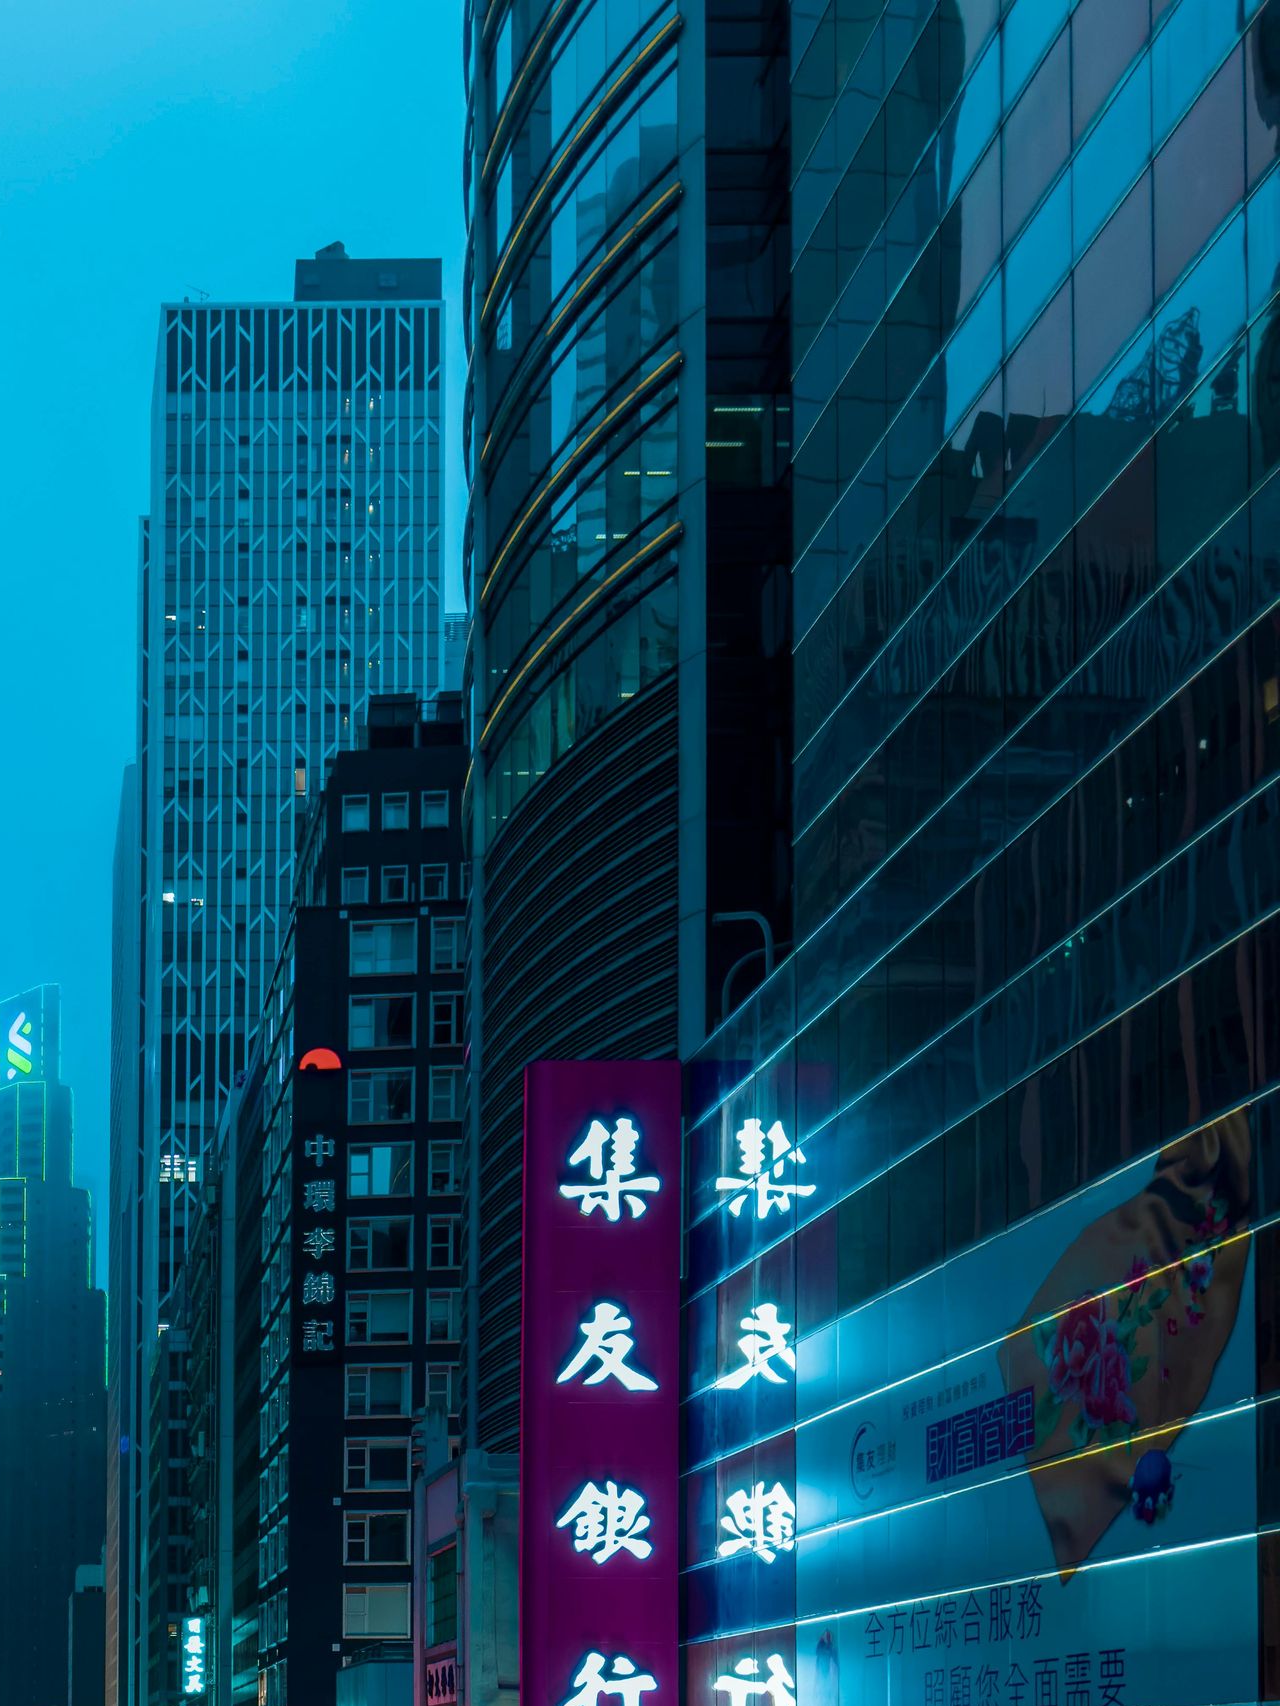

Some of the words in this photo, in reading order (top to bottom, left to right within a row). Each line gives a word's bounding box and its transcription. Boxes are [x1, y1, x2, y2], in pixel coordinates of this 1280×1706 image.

[302, 1133, 337, 1353] 中環李錦記
[926, 1388, 1034, 1484] 財富管理
[864, 1580, 1045, 1660] 全方位綜合服務
